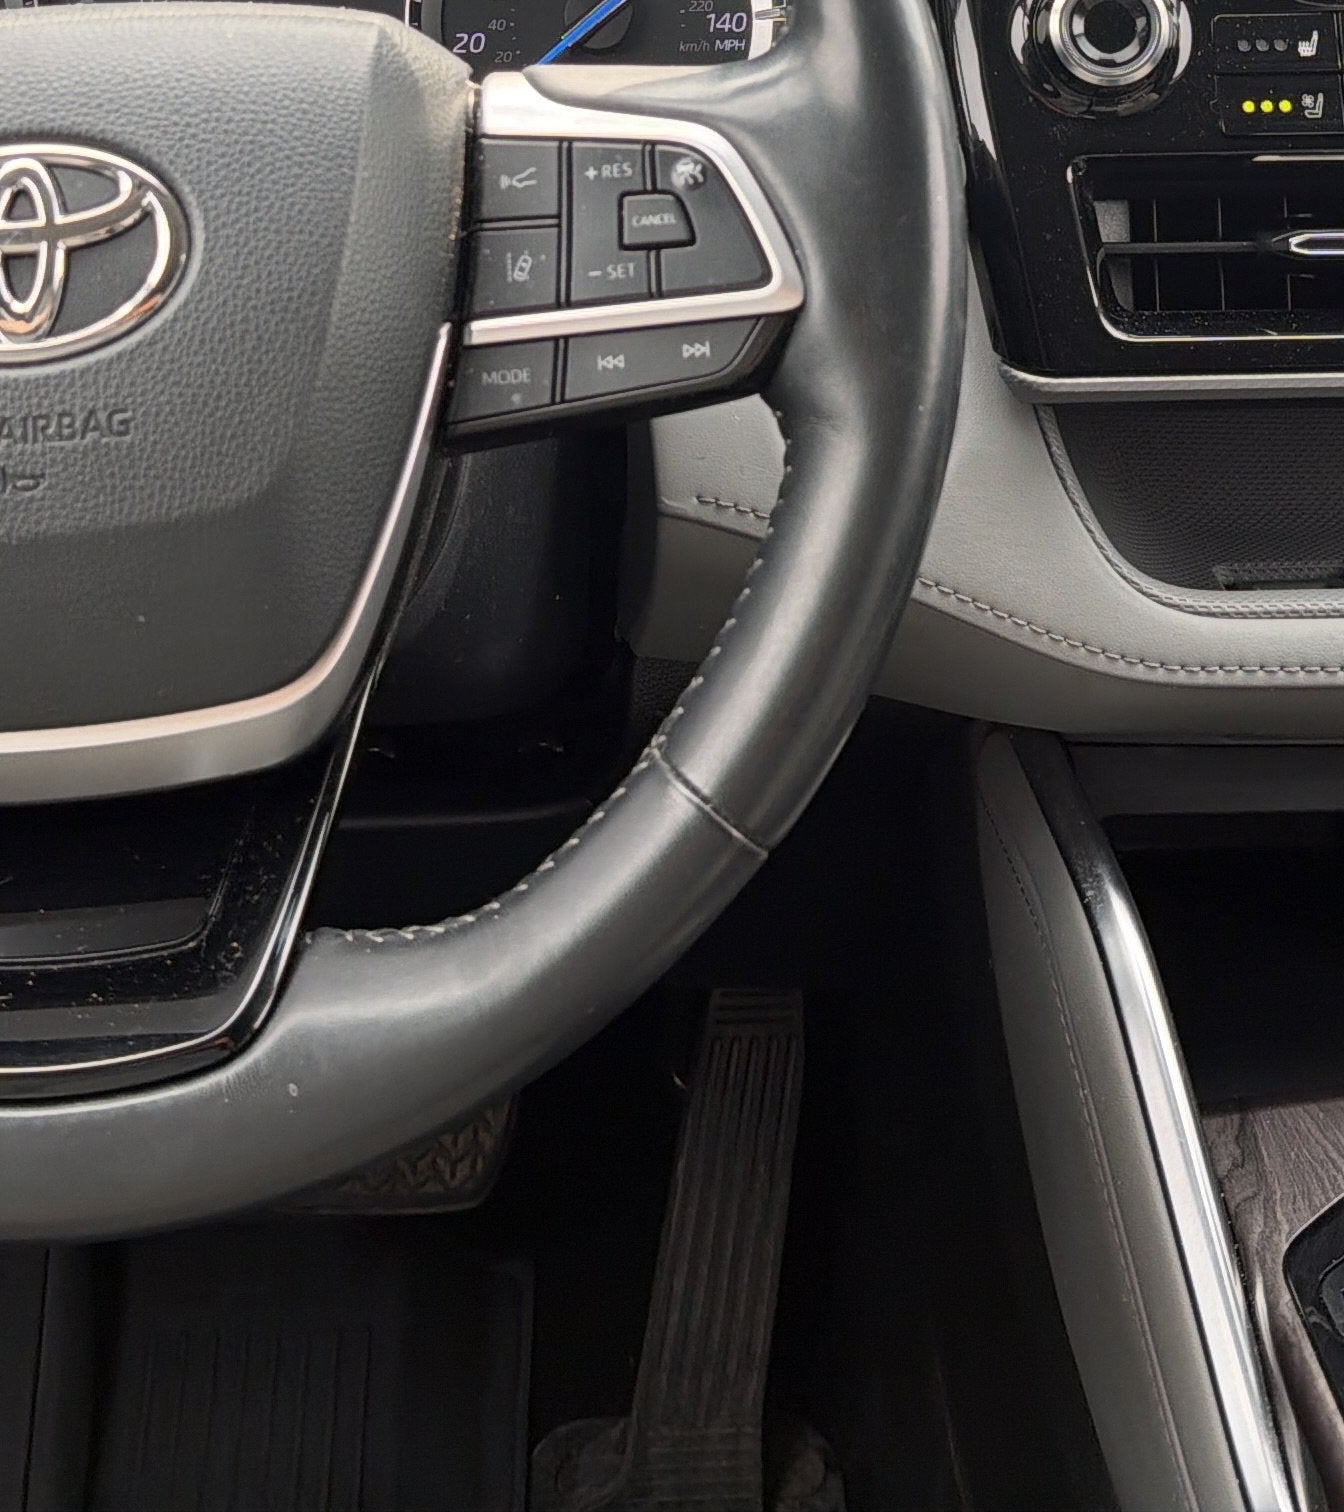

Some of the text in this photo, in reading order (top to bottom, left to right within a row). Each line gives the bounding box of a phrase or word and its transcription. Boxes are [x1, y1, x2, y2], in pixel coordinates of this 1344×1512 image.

[688, 0, 714, 13] 220
[488, 19, 506, 31] 40
[706, 12, 748, 33] 140
[453, 33, 486, 54] 20
[679, 39, 746, 53] km/h MPH
[495, 51, 513, 63] 20
[632, 213, 676, 226] CANCEL
[482, 368, 531, 385] MODE
